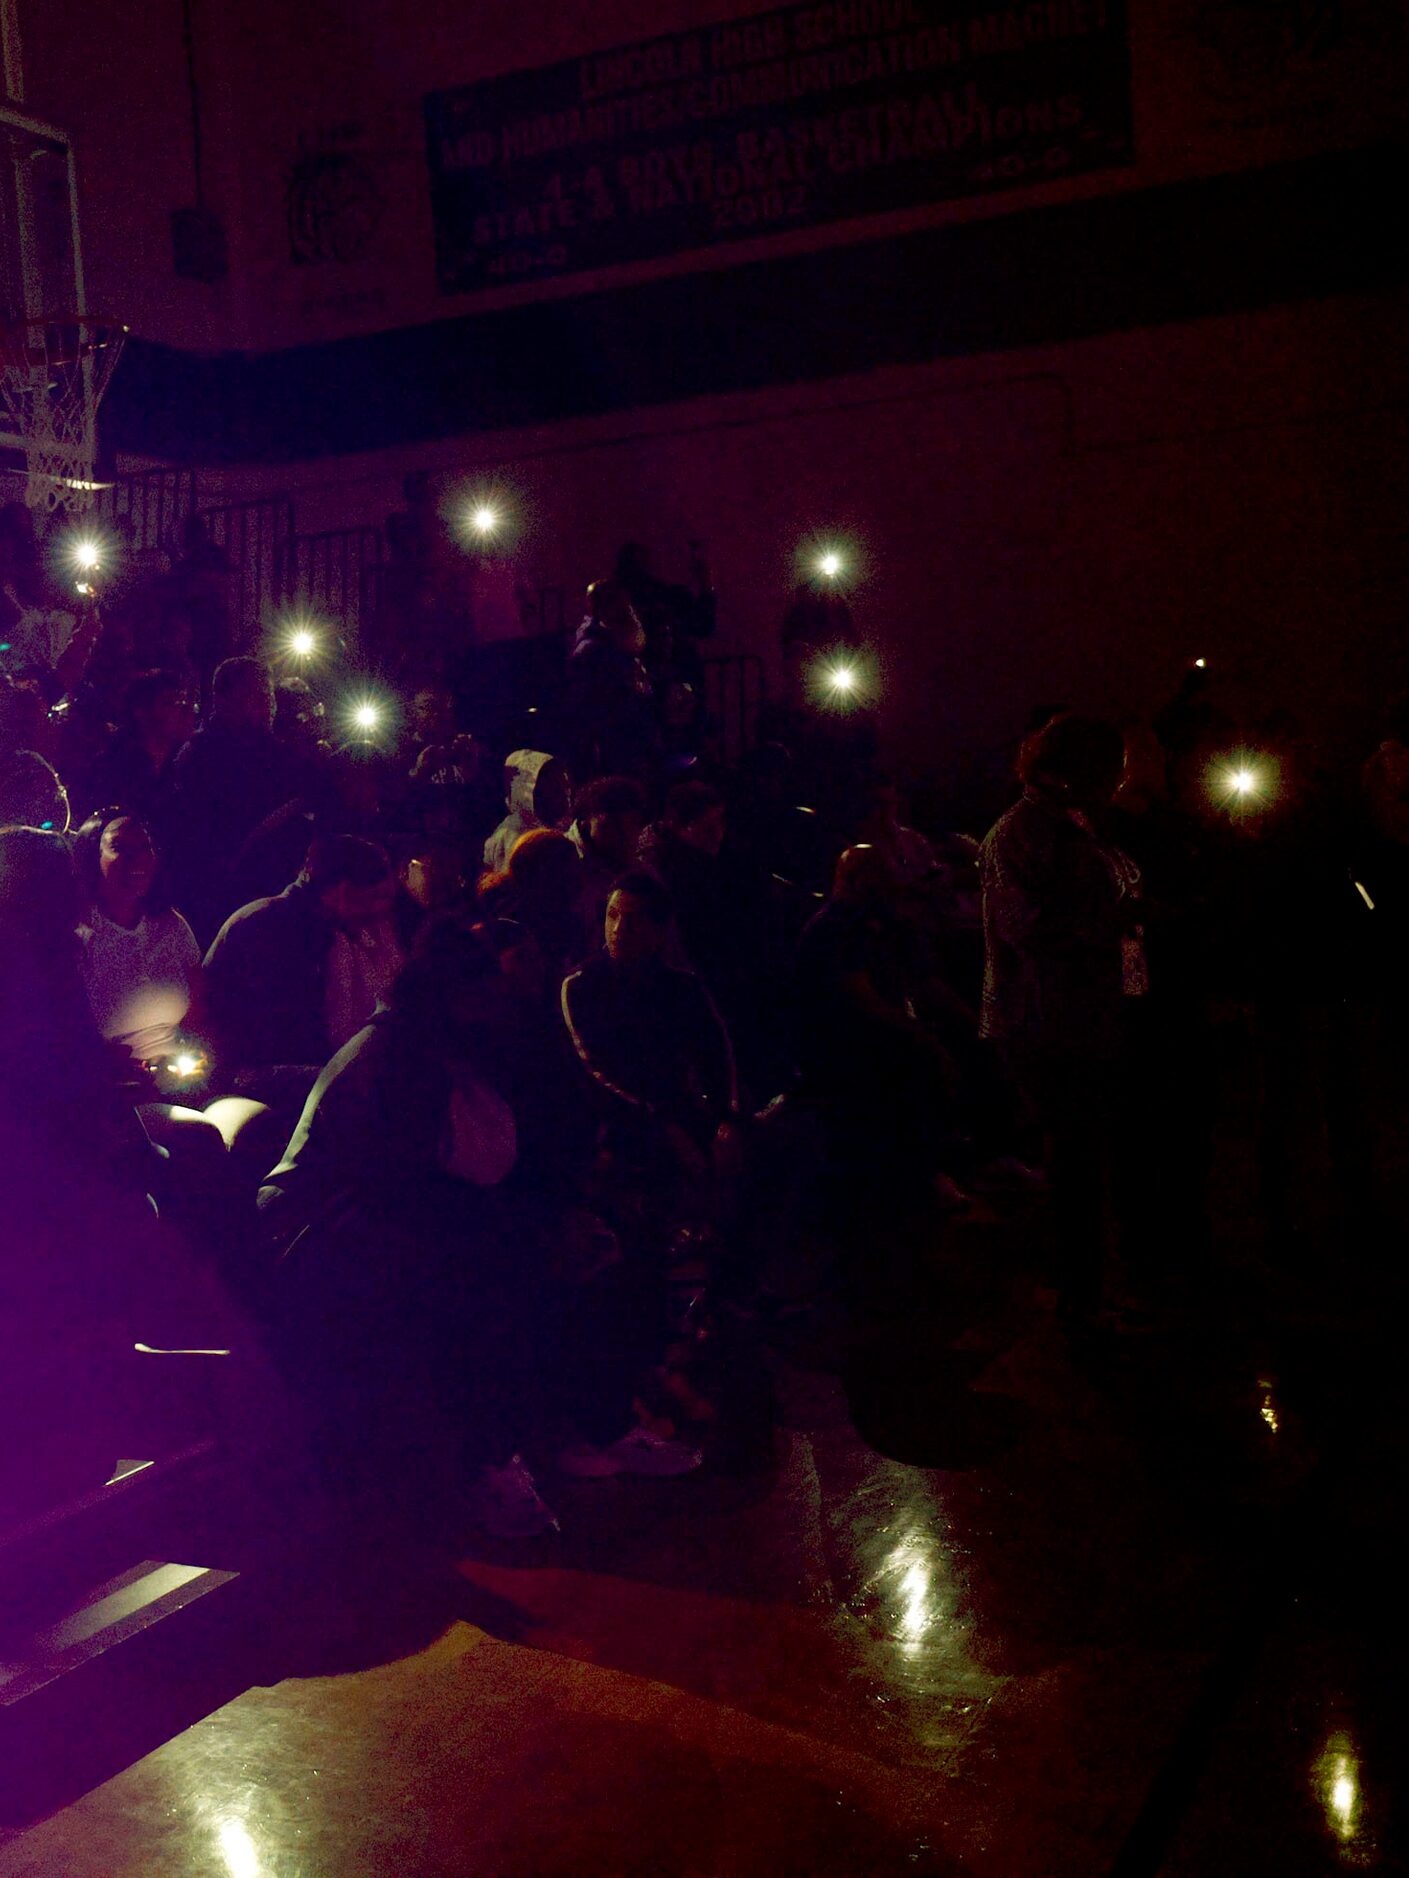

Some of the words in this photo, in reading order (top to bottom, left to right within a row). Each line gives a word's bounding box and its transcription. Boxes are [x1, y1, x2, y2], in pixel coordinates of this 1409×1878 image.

[580, 35, 702, 99] LINCOLN
[711, 16, 787, 71] HIGH
[793, 0, 922, 51] SCHOOL
[968, 0, 1107, 57] MAGNET
[471, 199, 577, 247] STATE
[628, 142, 817, 215] NATIONAL
[826, 92, 1085, 174] CHAMPIONS
[617, 139, 713, 188] BOYS
[735, 80, 981, 163] BASKETBALL
[713, 184, 809, 231] 2002
